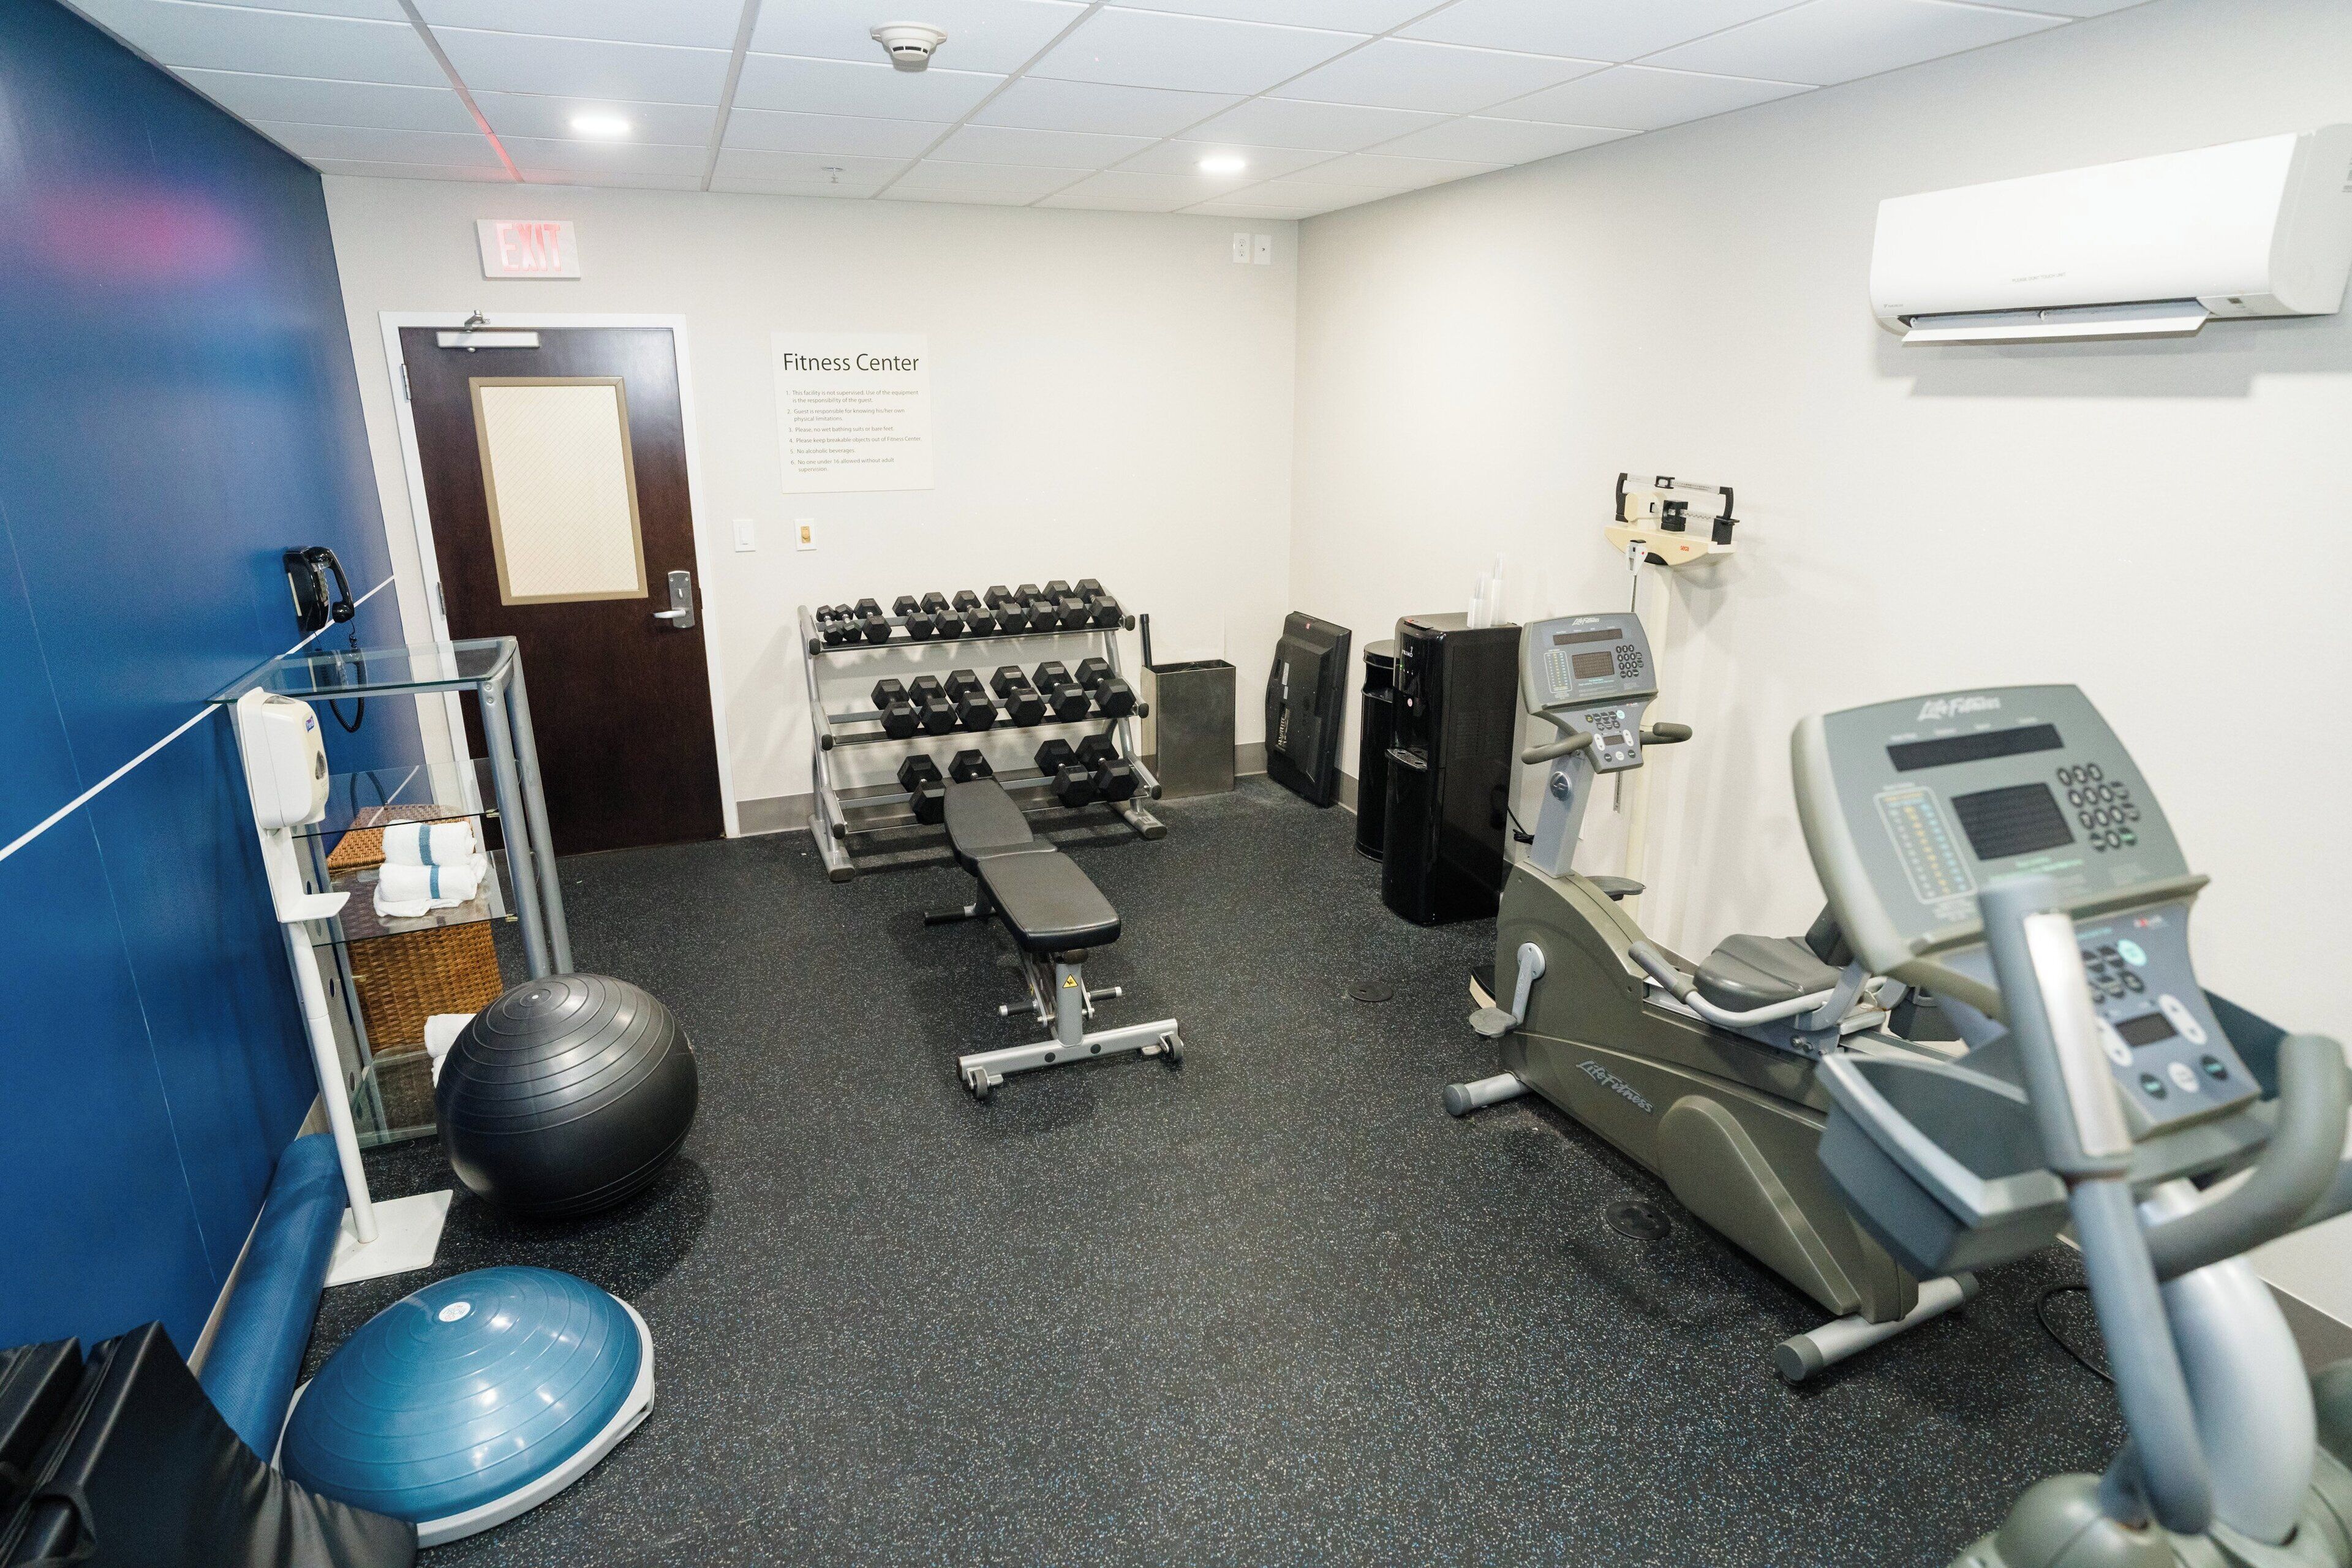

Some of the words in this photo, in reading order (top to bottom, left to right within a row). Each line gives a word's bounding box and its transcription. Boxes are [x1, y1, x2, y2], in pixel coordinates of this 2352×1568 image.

[497, 223, 561, 271] EXIT
[783, 353, 850, 371] Fitness
[856, 353, 919, 371] Center
